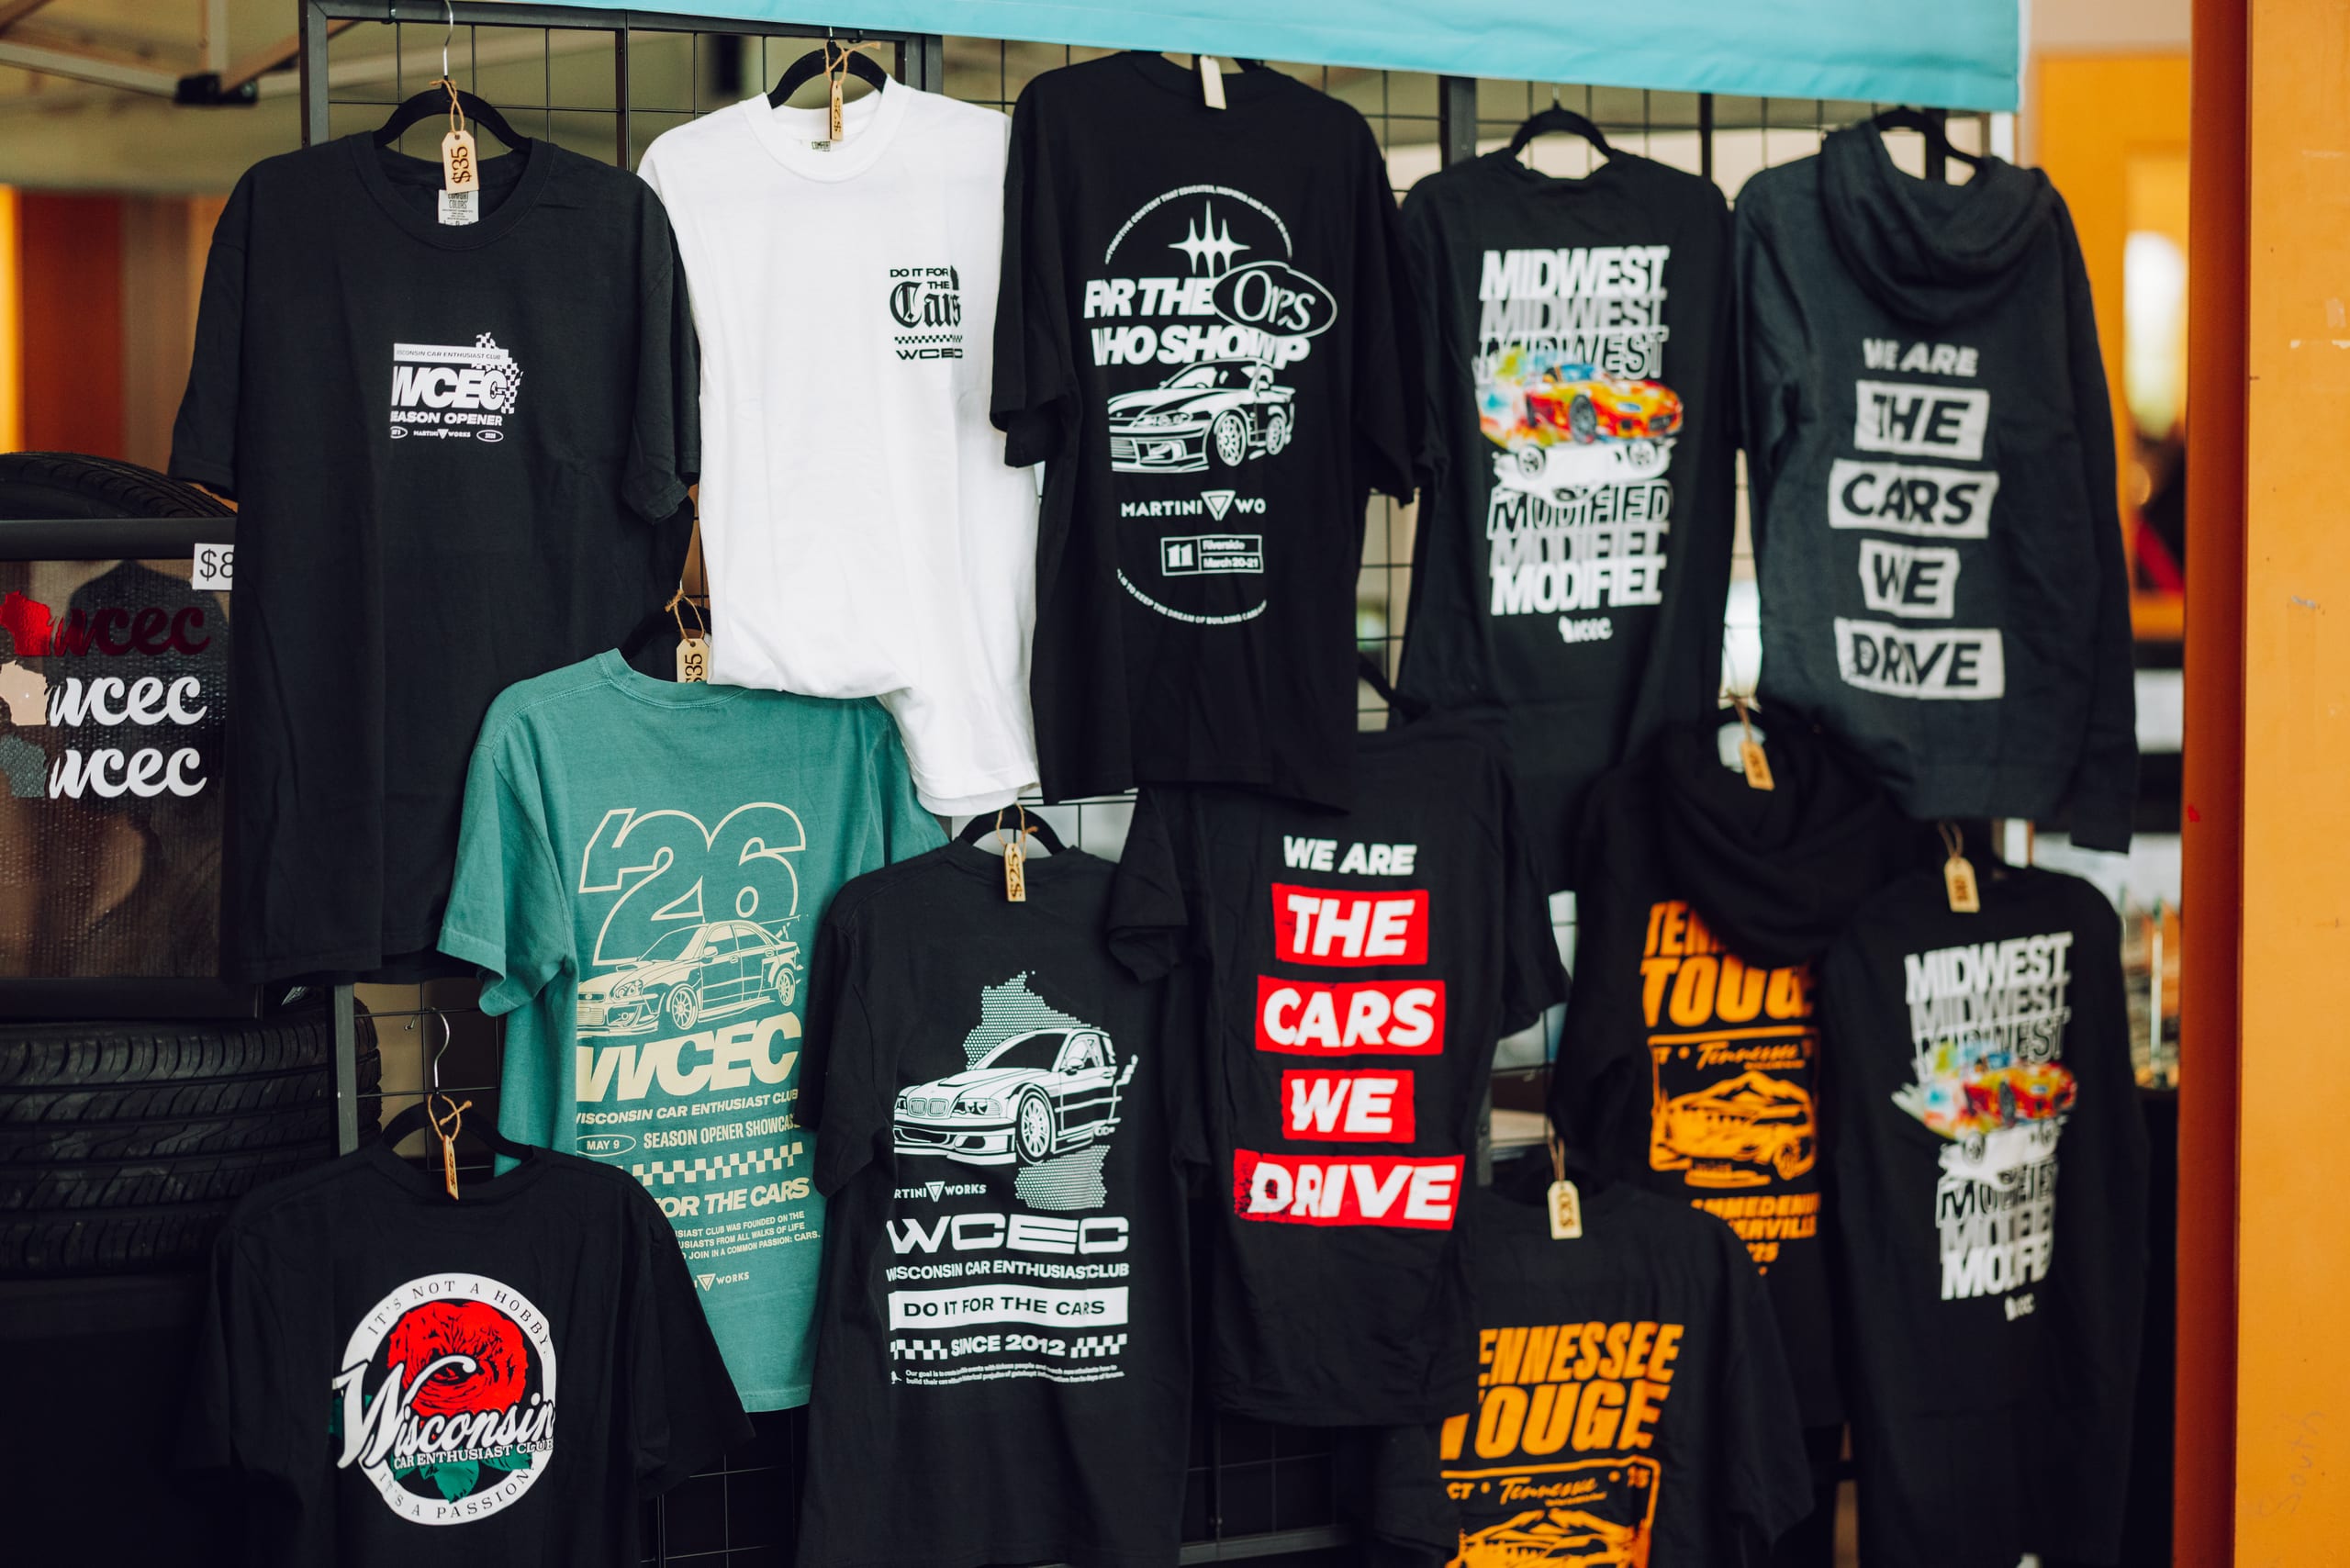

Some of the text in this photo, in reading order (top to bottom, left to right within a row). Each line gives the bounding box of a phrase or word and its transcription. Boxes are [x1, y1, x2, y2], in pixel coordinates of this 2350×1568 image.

[451, 146, 472, 184] $35
[890, 268, 949, 277] DO IT FOR
[927, 281, 949, 289] THE
[1479, 245, 1671, 301] MIDWEST
[1137, 277, 1217, 316] THE
[896, 348, 963, 360] WCEC
[1899, 342, 1978, 377] ARE
[391, 365, 507, 410] WCEC
[390, 411, 503, 426] EASON OPENER
[1873, 394, 1971, 444] THE
[1121, 500, 1203, 517] MARTINI
[1841, 472, 1981, 525] CARS
[1168, 543, 1193, 567] 11
[1203, 557, 1231, 568] March
[1874, 554, 1945, 604] WE
[1126, 583, 1136, 594] TO
[1134, 590, 1154, 606] KEEP
[1153, 602, 1169, 615] THE
[51, 607, 211, 657] wcec
[685, 654, 702, 682] 35
[49, 677, 207, 727] wcec
[49, 747, 207, 799] wcec
[1283, 835, 1417, 876] WE ARE
[1007, 853, 1023, 898] $25
[1287, 893, 1416, 958] THE
[1905, 931, 2074, 1005] MIDWEST
[1263, 987, 1437, 1048] CARS
[576, 1012, 801, 1102] WCEC
[656, 1105, 688, 1120] CAR
[691, 1094, 770, 1116] ENTHUSIAST
[772, 1089, 799, 1104] CLUB
[1291, 1078, 1398, 1133] WE
[587, 1139, 621, 1151] MAY 9
[643, 1129, 698, 1149] SEASON
[700, 1124, 744, 1144] OPENER
[704, 1189, 747, 1215] THE
[750, 1177, 810, 1207] CARS
[945, 1184, 987, 1196] WORKS
[1247, 1161, 1457, 1221] DRIVE
[678, 1222, 805, 1249] USIASTS FROM ALL WALKS OF LIFE
[706, 1226, 725, 1236] CLUB
[726, 1224, 742, 1232] WAS
[743, 1216, 776, 1229] FOUNDED
[789, 1211, 804, 1220] THE
[886, 1213, 1129, 1254] WCEC
[688, 1250, 710, 1260] JOIN
[711, 1249, 719, 1258] IN
[727, 1243, 757, 1254] COMMON
[759, 1235, 793, 1249] PASSION:
[794, 1231, 821, 1242] CARS.
[716, 1271, 750, 1285] WORKS
[965, 1260, 990, 1274] CAR
[1087, 1263, 1130, 1278] CLUB
[367, 1296, 403, 1335] IT'S
[412, 1281, 455, 1300] NOT
[470, 1282, 480, 1294] A
[903, 1296, 1105, 1316] DO IT FOR THE CARS
[951, 1335, 1065, 1357] SINCE 2012
[1478, 1321, 1684, 1387] ENNESSEE
[332, 1355, 554, 1469] Wisconsin
[393, 1439, 554, 1470] CAR ENTHUSIAST CLUB
[379, 1473, 405, 1507] IT'S
[411, 1504, 421, 1516] A
